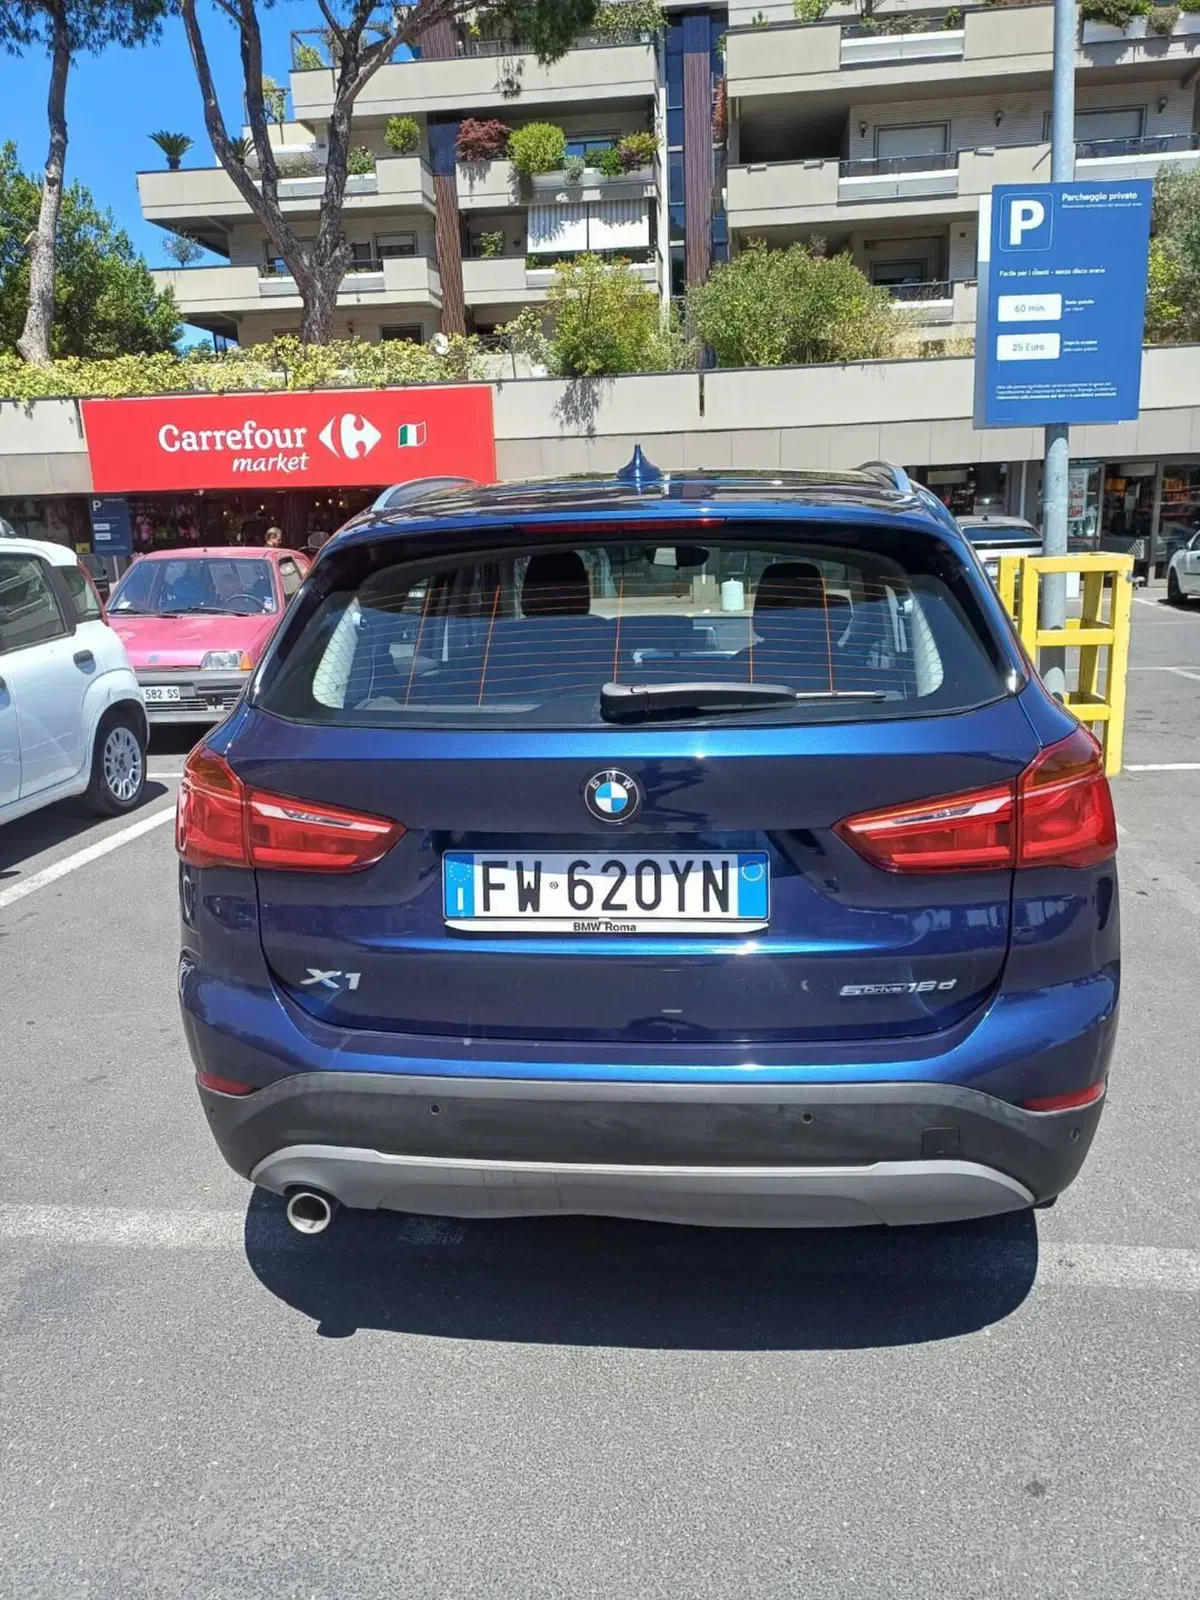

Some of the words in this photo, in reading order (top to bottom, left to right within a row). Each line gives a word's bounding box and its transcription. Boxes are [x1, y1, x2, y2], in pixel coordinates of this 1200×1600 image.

[1061, 192, 1107, 203] Parcheggio
[1108, 191, 1139, 202] privato
[1009, 199, 1045, 246] P
[1017, 270, 1028, 279] per
[1014, 303, 1026, 313] 60
[1028, 302, 1046, 312] min.
[1012, 343, 1023, 352] 25
[1026, 342, 1045, 352] Euro
[158, 419, 307, 452] Carrefour
[232, 451, 310, 473] market
[92, 500, 102, 511] P
[145, 689, 163, 699] 582
[167, 688, 179, 699] SS
[589, 771, 634, 790] BMW
[482, 859, 542, 912] FW
[573, 921, 601, 932] BMW
[604, 921, 637, 932] Roma
[299, 967, 362, 990] X1
